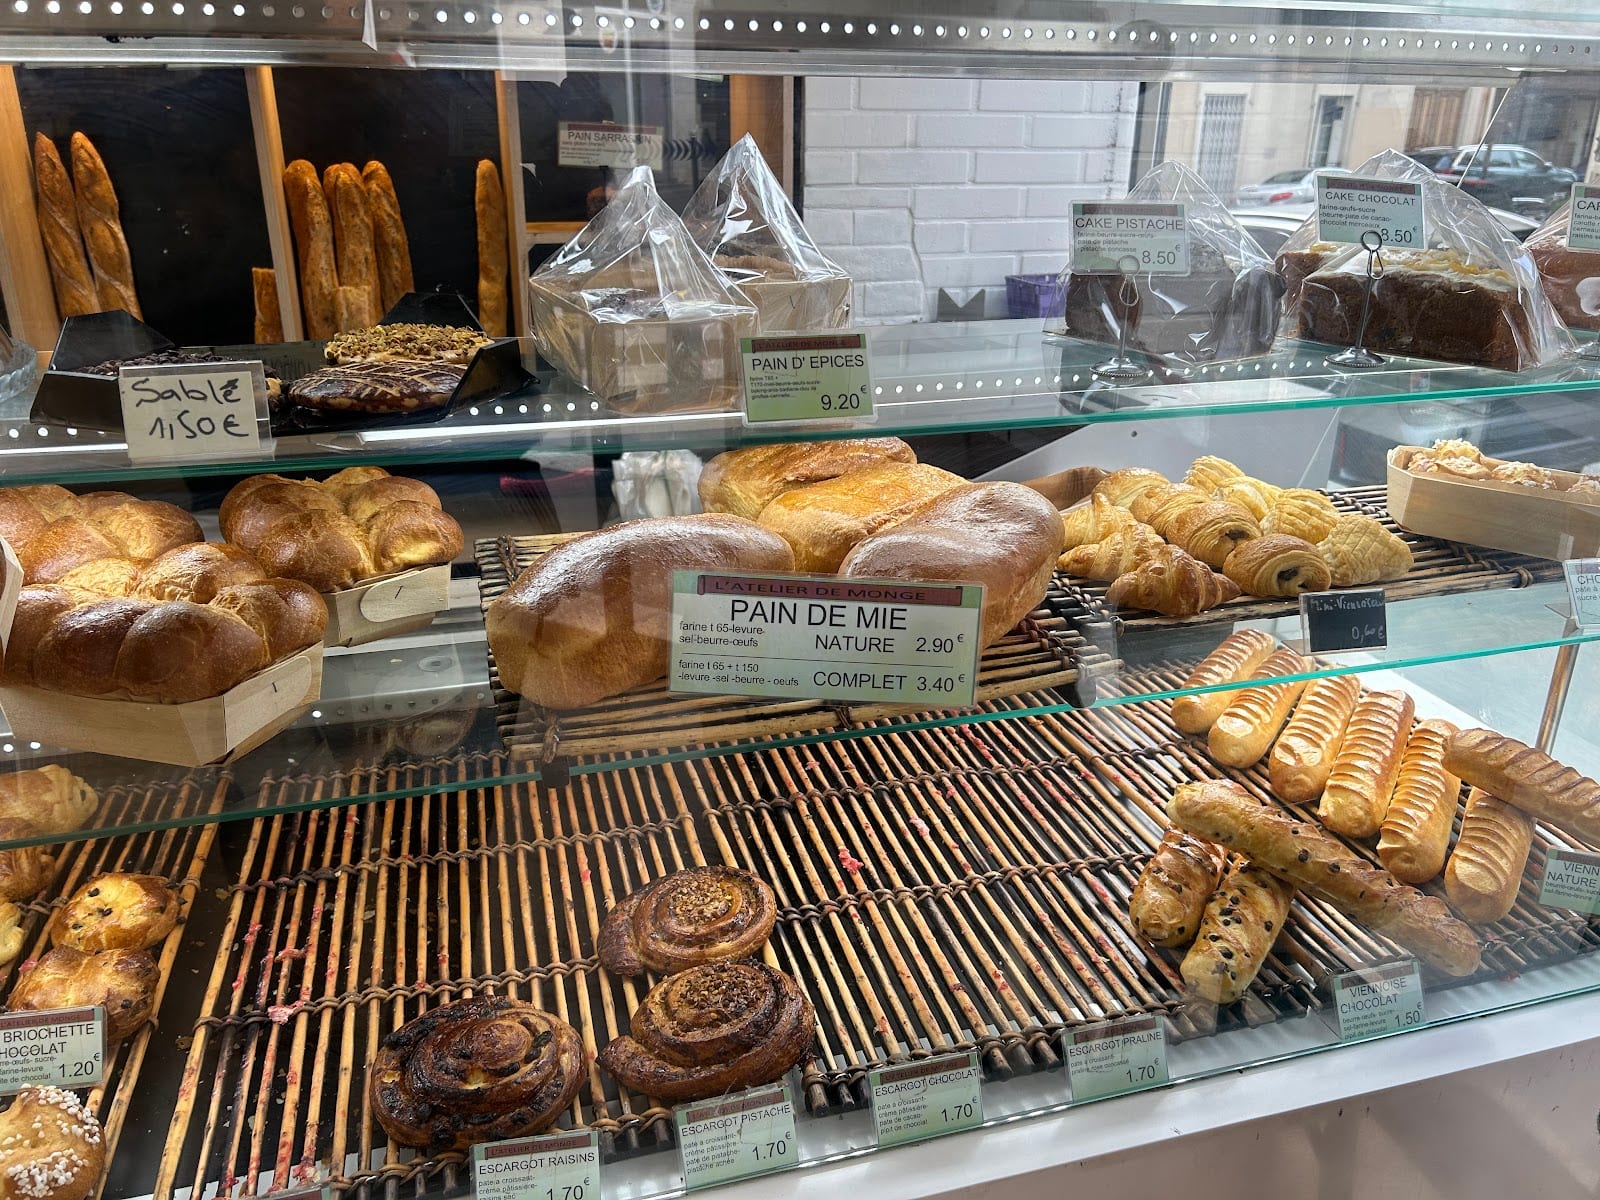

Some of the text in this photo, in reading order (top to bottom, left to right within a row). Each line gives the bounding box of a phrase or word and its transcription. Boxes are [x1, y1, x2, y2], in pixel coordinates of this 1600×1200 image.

[567, 131, 591, 141] PAIN
[1325, 191, 1416, 207] CAKE CHOCOLAT
[1075, 217, 1184, 231] CAKE PISTACHE
[752, 357, 788, 371] PAIN
[810, 354, 865, 369] EPICES
[715, 580, 927, 601] L'ATELIER DE MONGE
[730, 599, 908, 630] PAIN DE MIE
[679, 620, 708, 633] farine
[814, 634, 896, 653] NATURE
[678, 659, 705, 671] farine
[712, 661, 725, 672] 65
[742, 663, 759, 673] 150
[813, 671, 907, 691] COMPLET
[1547, 871, 1598, 889] NATURE
[1349, 977, 1407, 998] VIENNOISE
[1340, 993, 1398, 1014] CHOCOLAT
[3, 1023, 95, 1043] BRIOCHETTE
[1069, 1031, 1162, 1057] ESCARGOT PRALINE
[9, 1076, 20, 1084] de
[20, 1072, 51, 1082] chocolat
[875, 1078, 927, 1097] ESCARGOT
[928, 1068, 978, 1086] CHOCOLAT
[681, 1104, 791, 1138] ESCARGOT PISTACHE
[479, 1152, 595, 1175] ESCARGOT RAISINS
